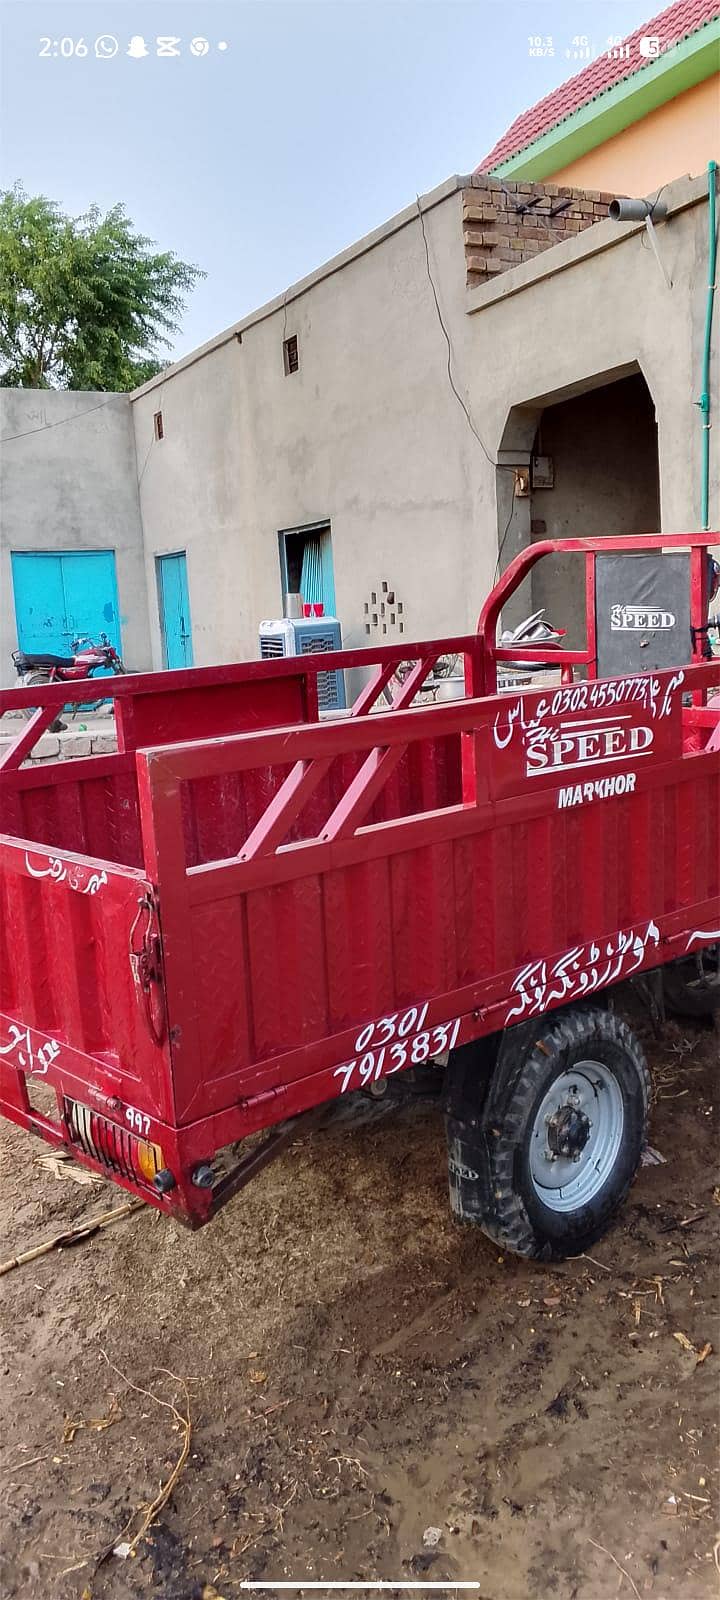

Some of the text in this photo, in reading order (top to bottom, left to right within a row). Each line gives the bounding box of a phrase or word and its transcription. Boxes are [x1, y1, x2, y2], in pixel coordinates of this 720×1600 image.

[610, 613, 676, 629] SPEED
[525, 726, 559, 745] Hi
[526, 726, 654, 770] SPEED
[557, 772, 637, 809] MARKHOR
[355, 1001, 429, 1052] 0301
[333, 1017, 461, 1094] 7913831
[125, 1107, 151, 1135] 997
